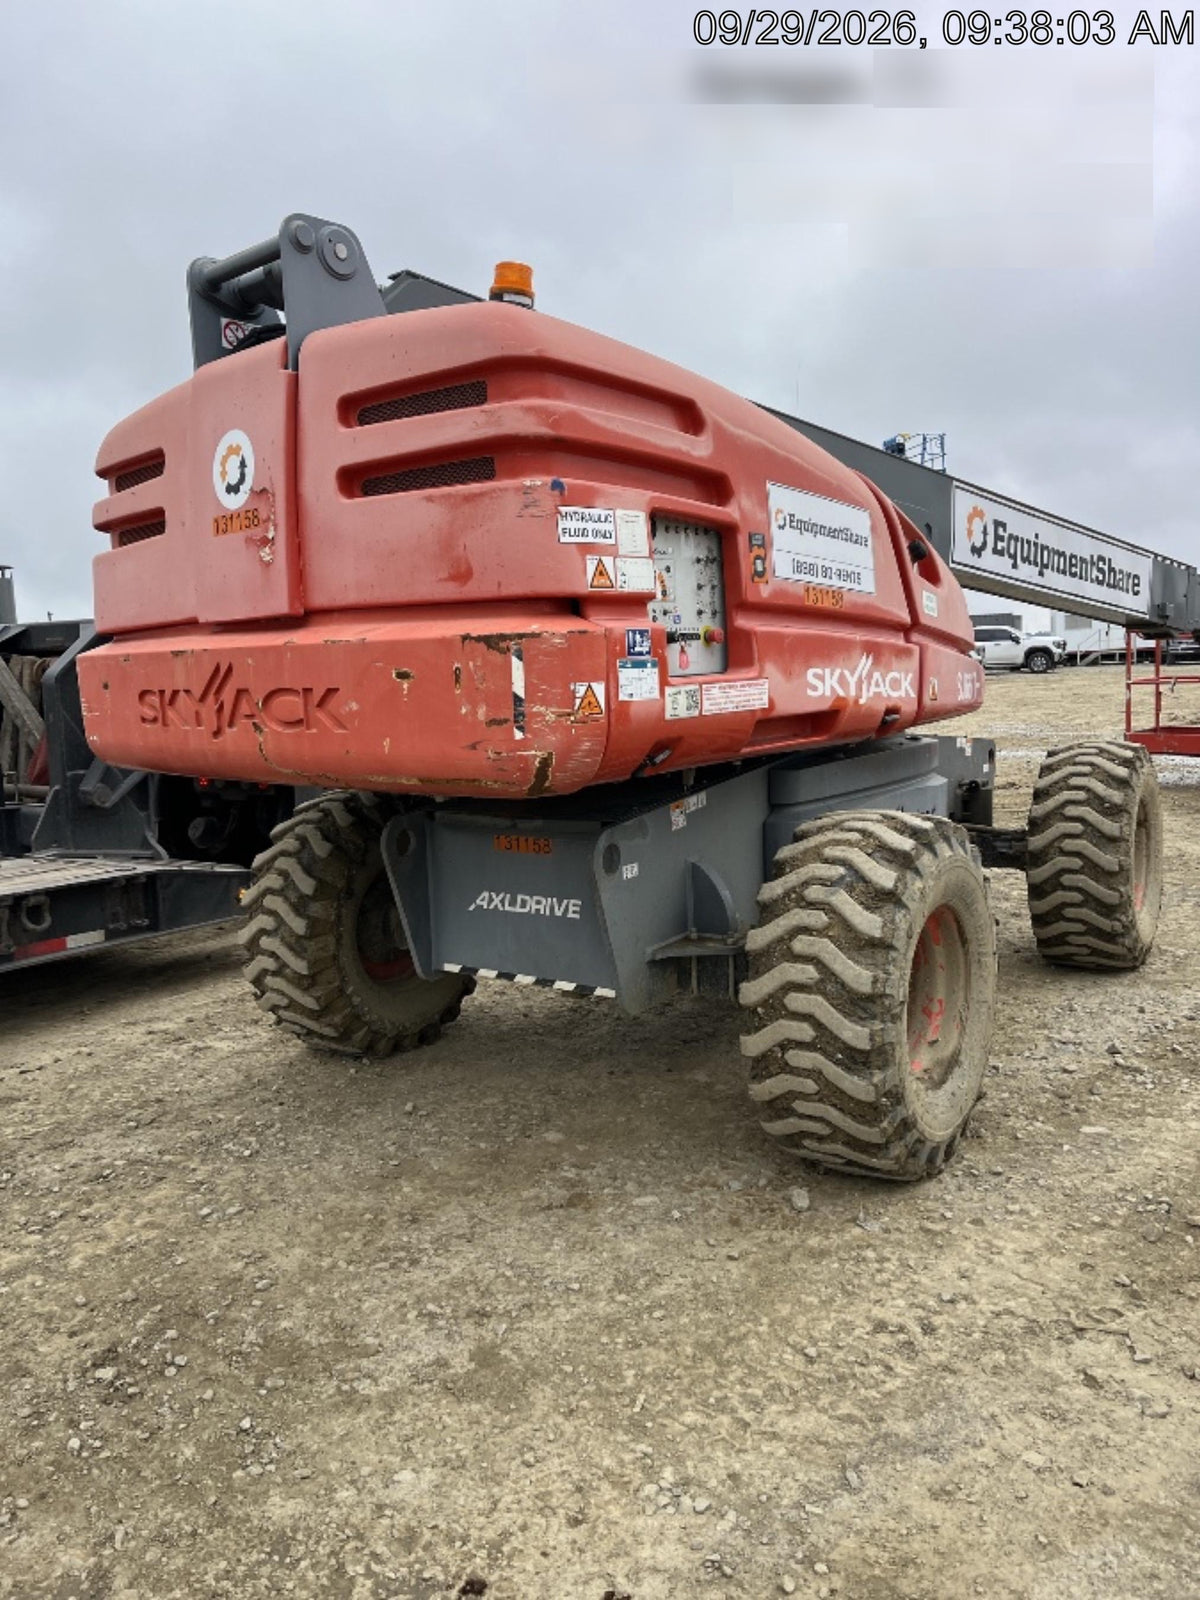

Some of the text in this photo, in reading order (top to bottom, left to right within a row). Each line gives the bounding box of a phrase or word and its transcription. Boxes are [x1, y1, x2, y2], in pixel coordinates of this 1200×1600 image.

[213, 508, 260, 535] 131158
[560, 511, 613, 523] HYDRAULIC
[787, 512, 869, 547] EquipmentShare
[561, 527, 614, 539] FLUID ONLY
[991, 519, 1142, 596] EquipmentShare
[806, 652, 917, 705] SKYJACK
[137, 662, 349, 741] SKYJACK
[494, 835, 552, 855] 131158
[468, 891, 582, 919] AXLDRIVE
